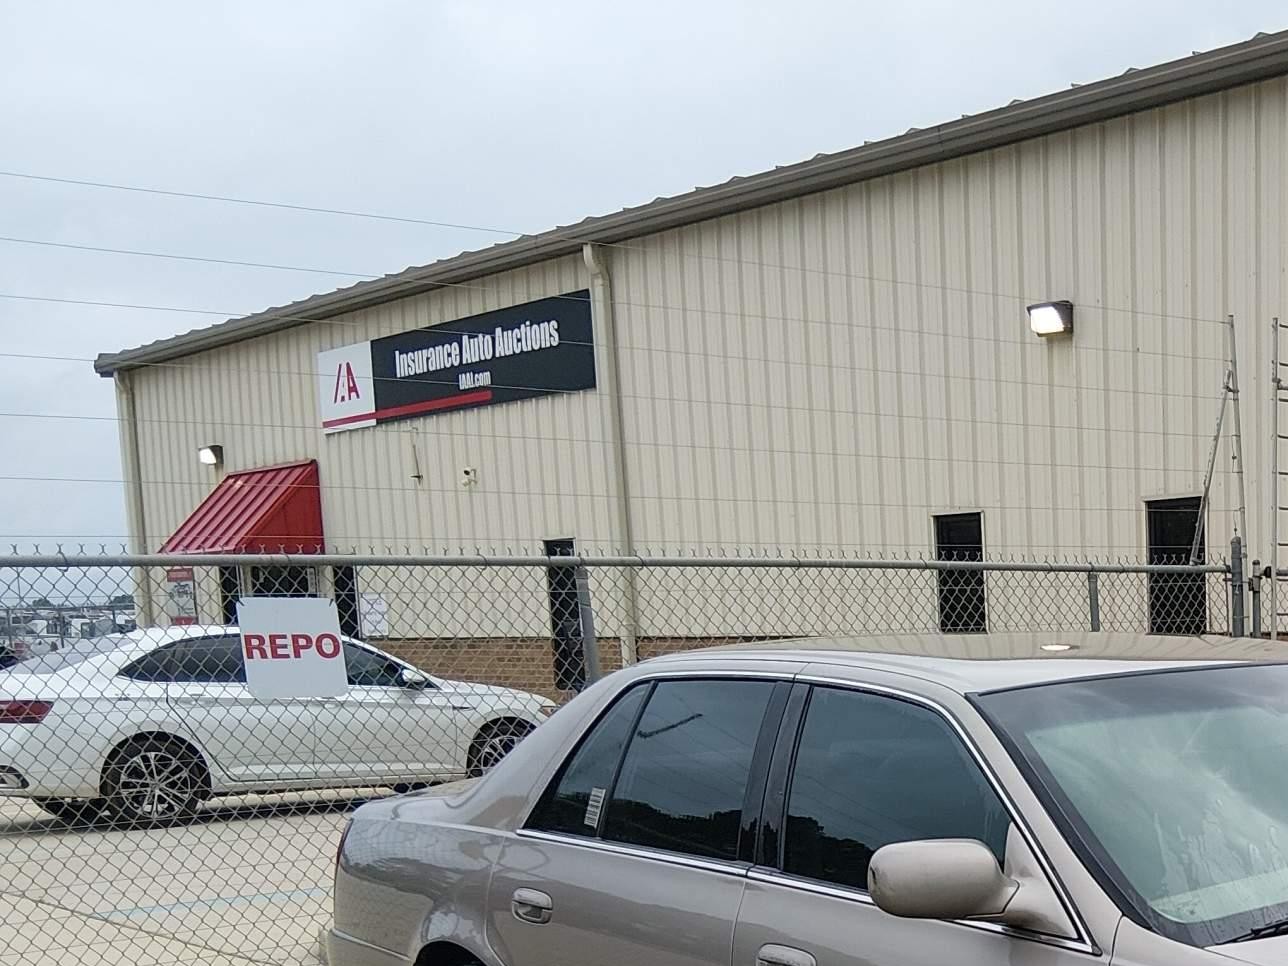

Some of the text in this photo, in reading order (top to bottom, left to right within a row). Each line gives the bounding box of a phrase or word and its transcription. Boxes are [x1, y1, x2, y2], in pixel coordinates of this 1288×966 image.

[394, 319, 560, 378] Insurance Auto Auctions
[243, 633, 341, 660] REPO
